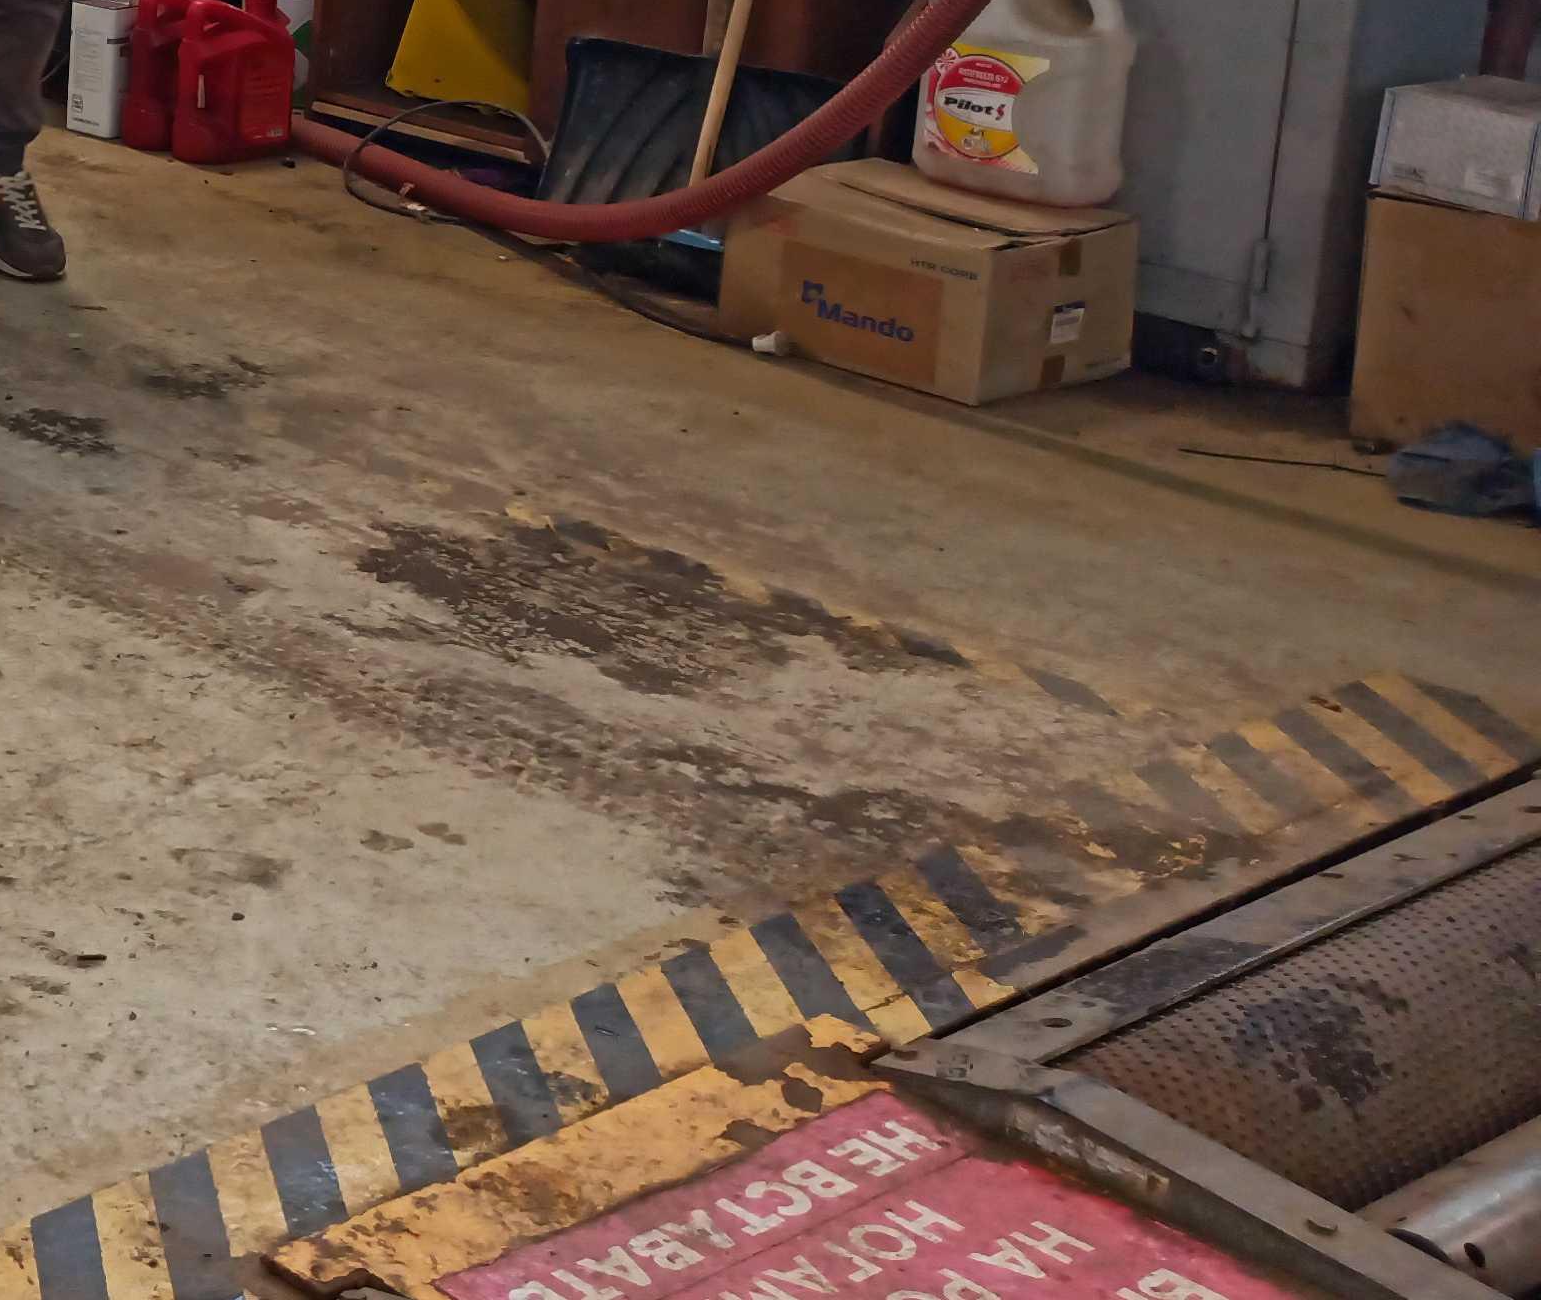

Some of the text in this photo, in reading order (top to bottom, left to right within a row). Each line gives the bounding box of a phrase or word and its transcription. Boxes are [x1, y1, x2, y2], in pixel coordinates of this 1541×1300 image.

[815, 298, 915, 343] Mando
[827, 1120, 942, 1175] НЕ
[967, 1220, 1095, 1280] НА
